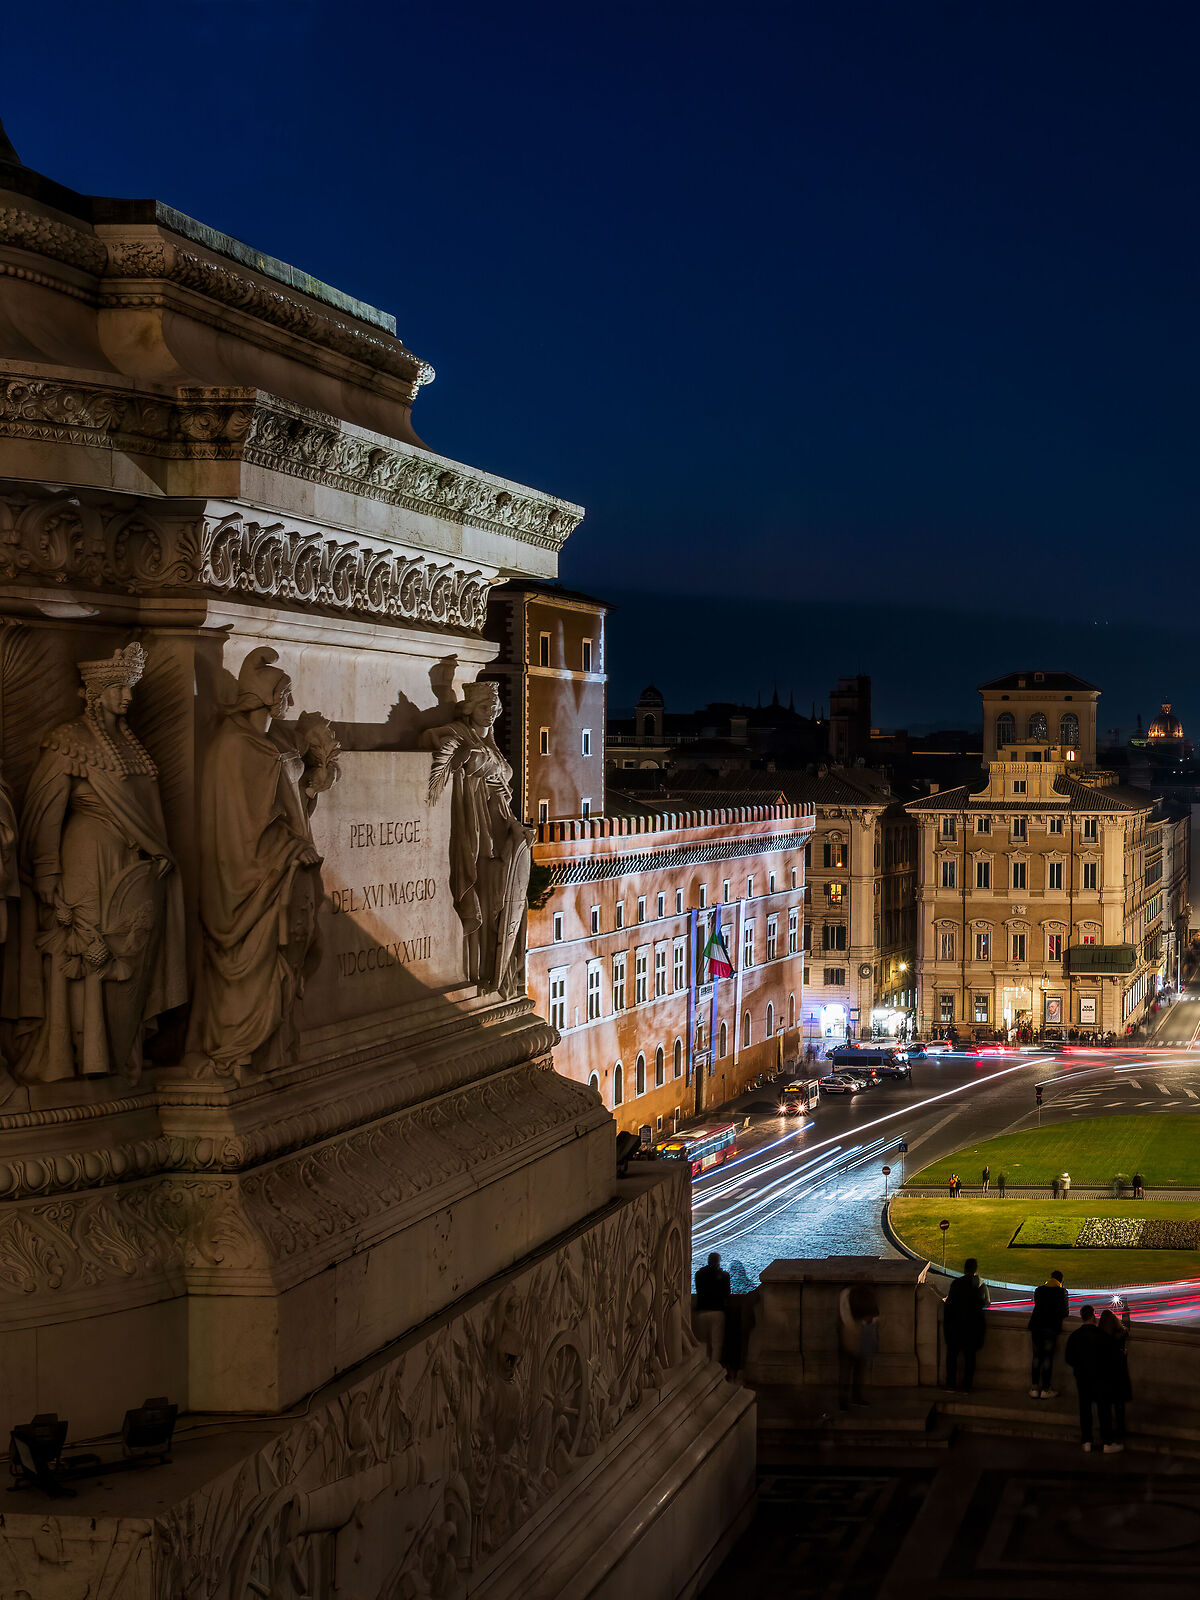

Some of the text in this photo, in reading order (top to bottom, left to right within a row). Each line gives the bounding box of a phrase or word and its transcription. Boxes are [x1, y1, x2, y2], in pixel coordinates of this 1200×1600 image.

[380, 820, 421, 846] LEGGE
[331, 878, 436, 915] DEL XVI MAGGIO
